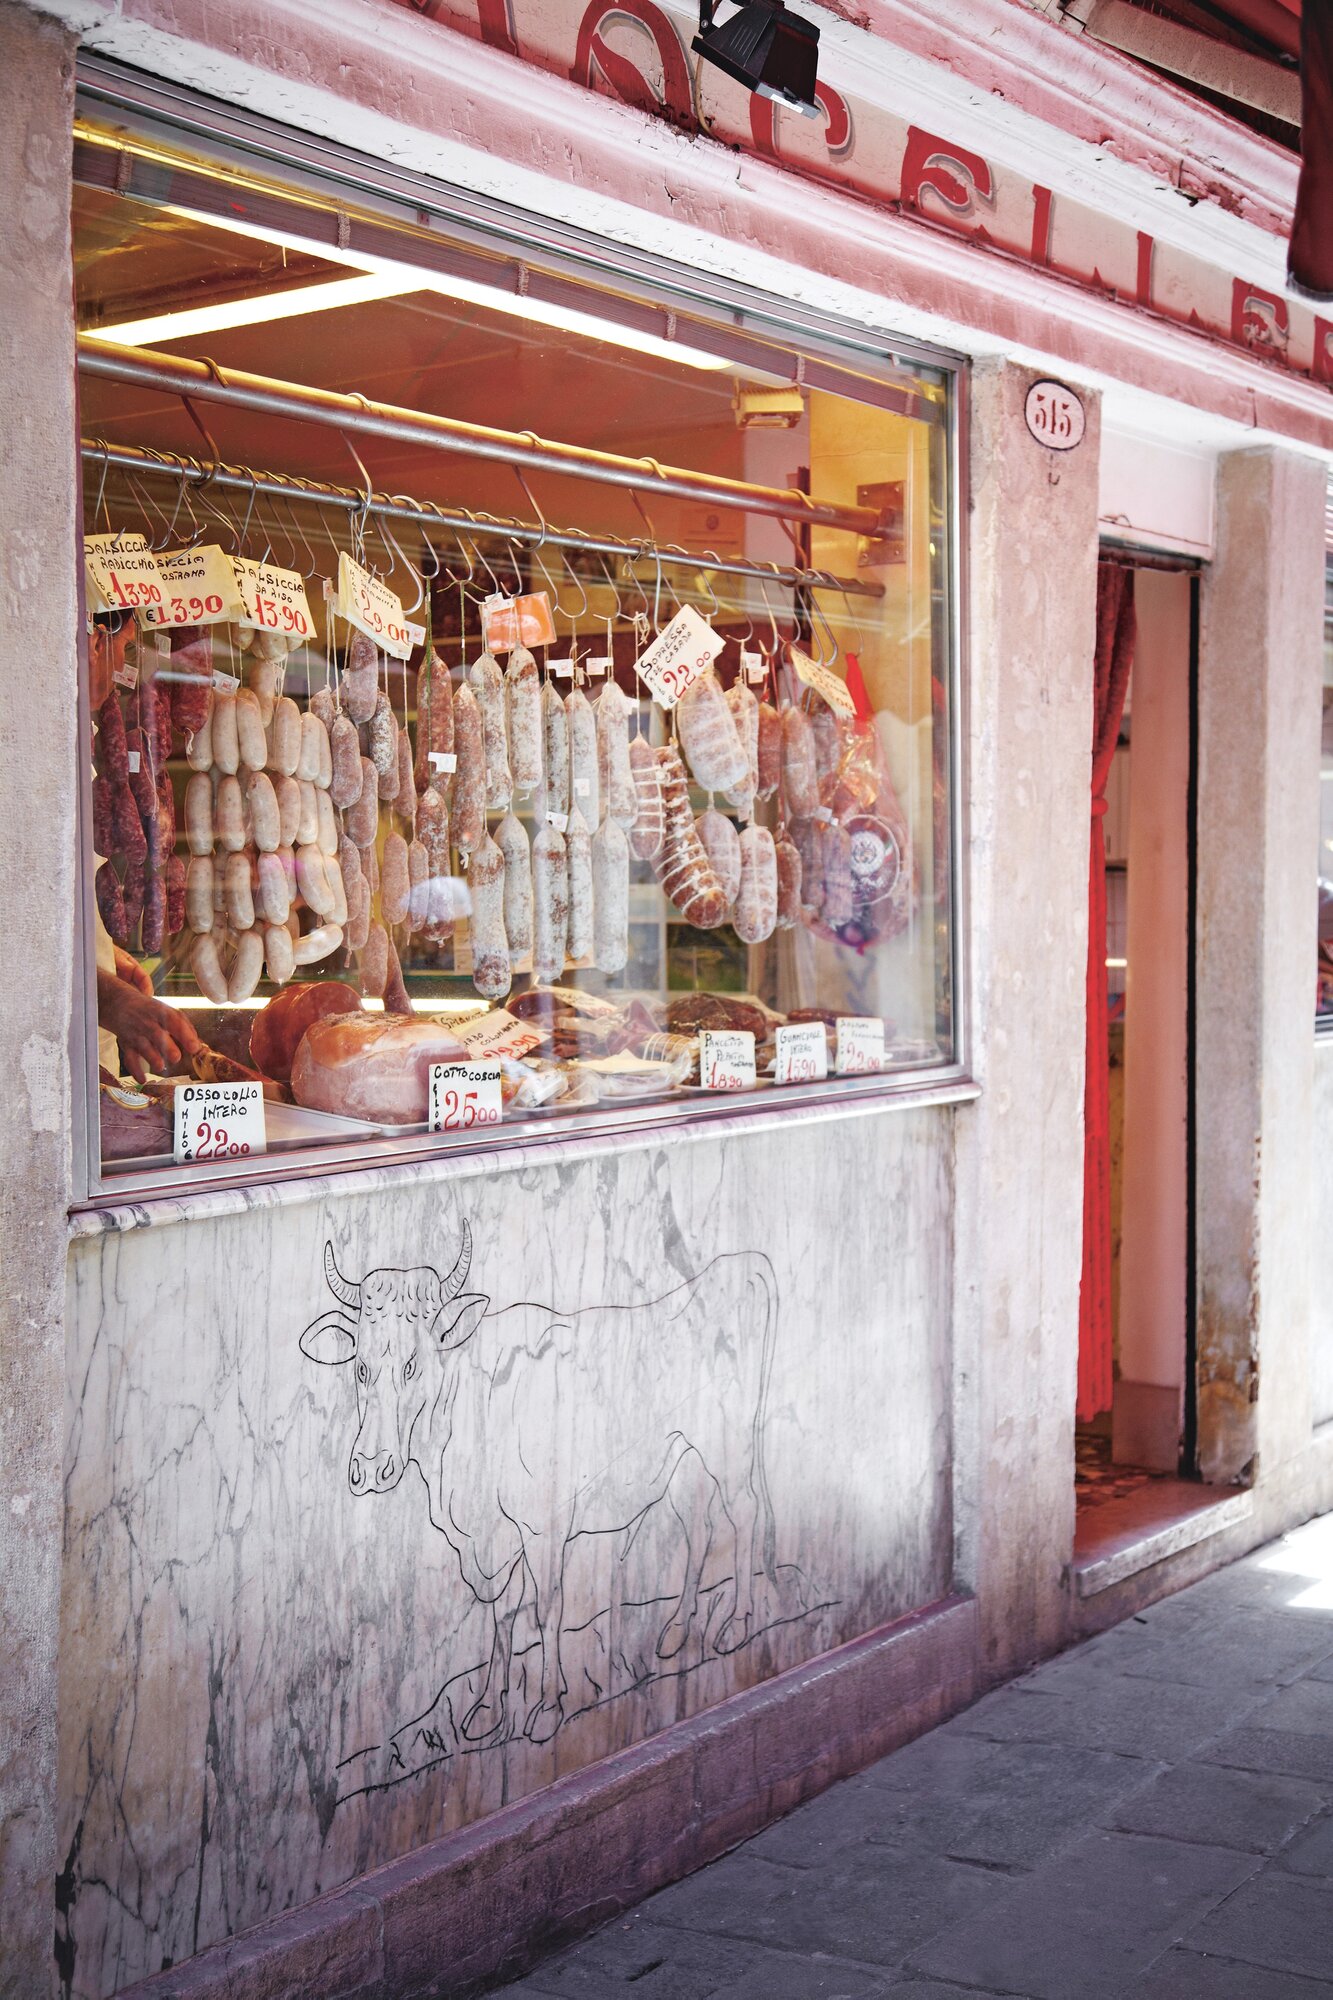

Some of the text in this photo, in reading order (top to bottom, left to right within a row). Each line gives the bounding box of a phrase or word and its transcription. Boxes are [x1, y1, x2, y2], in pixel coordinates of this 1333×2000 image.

[100, 556, 155, 570] RADICCHIO
[233, 557, 304, 593] SALSICCIA
[434, 1065, 501, 1081] COTTO COSCIA
[202, 1101, 248, 1121] INTERO
